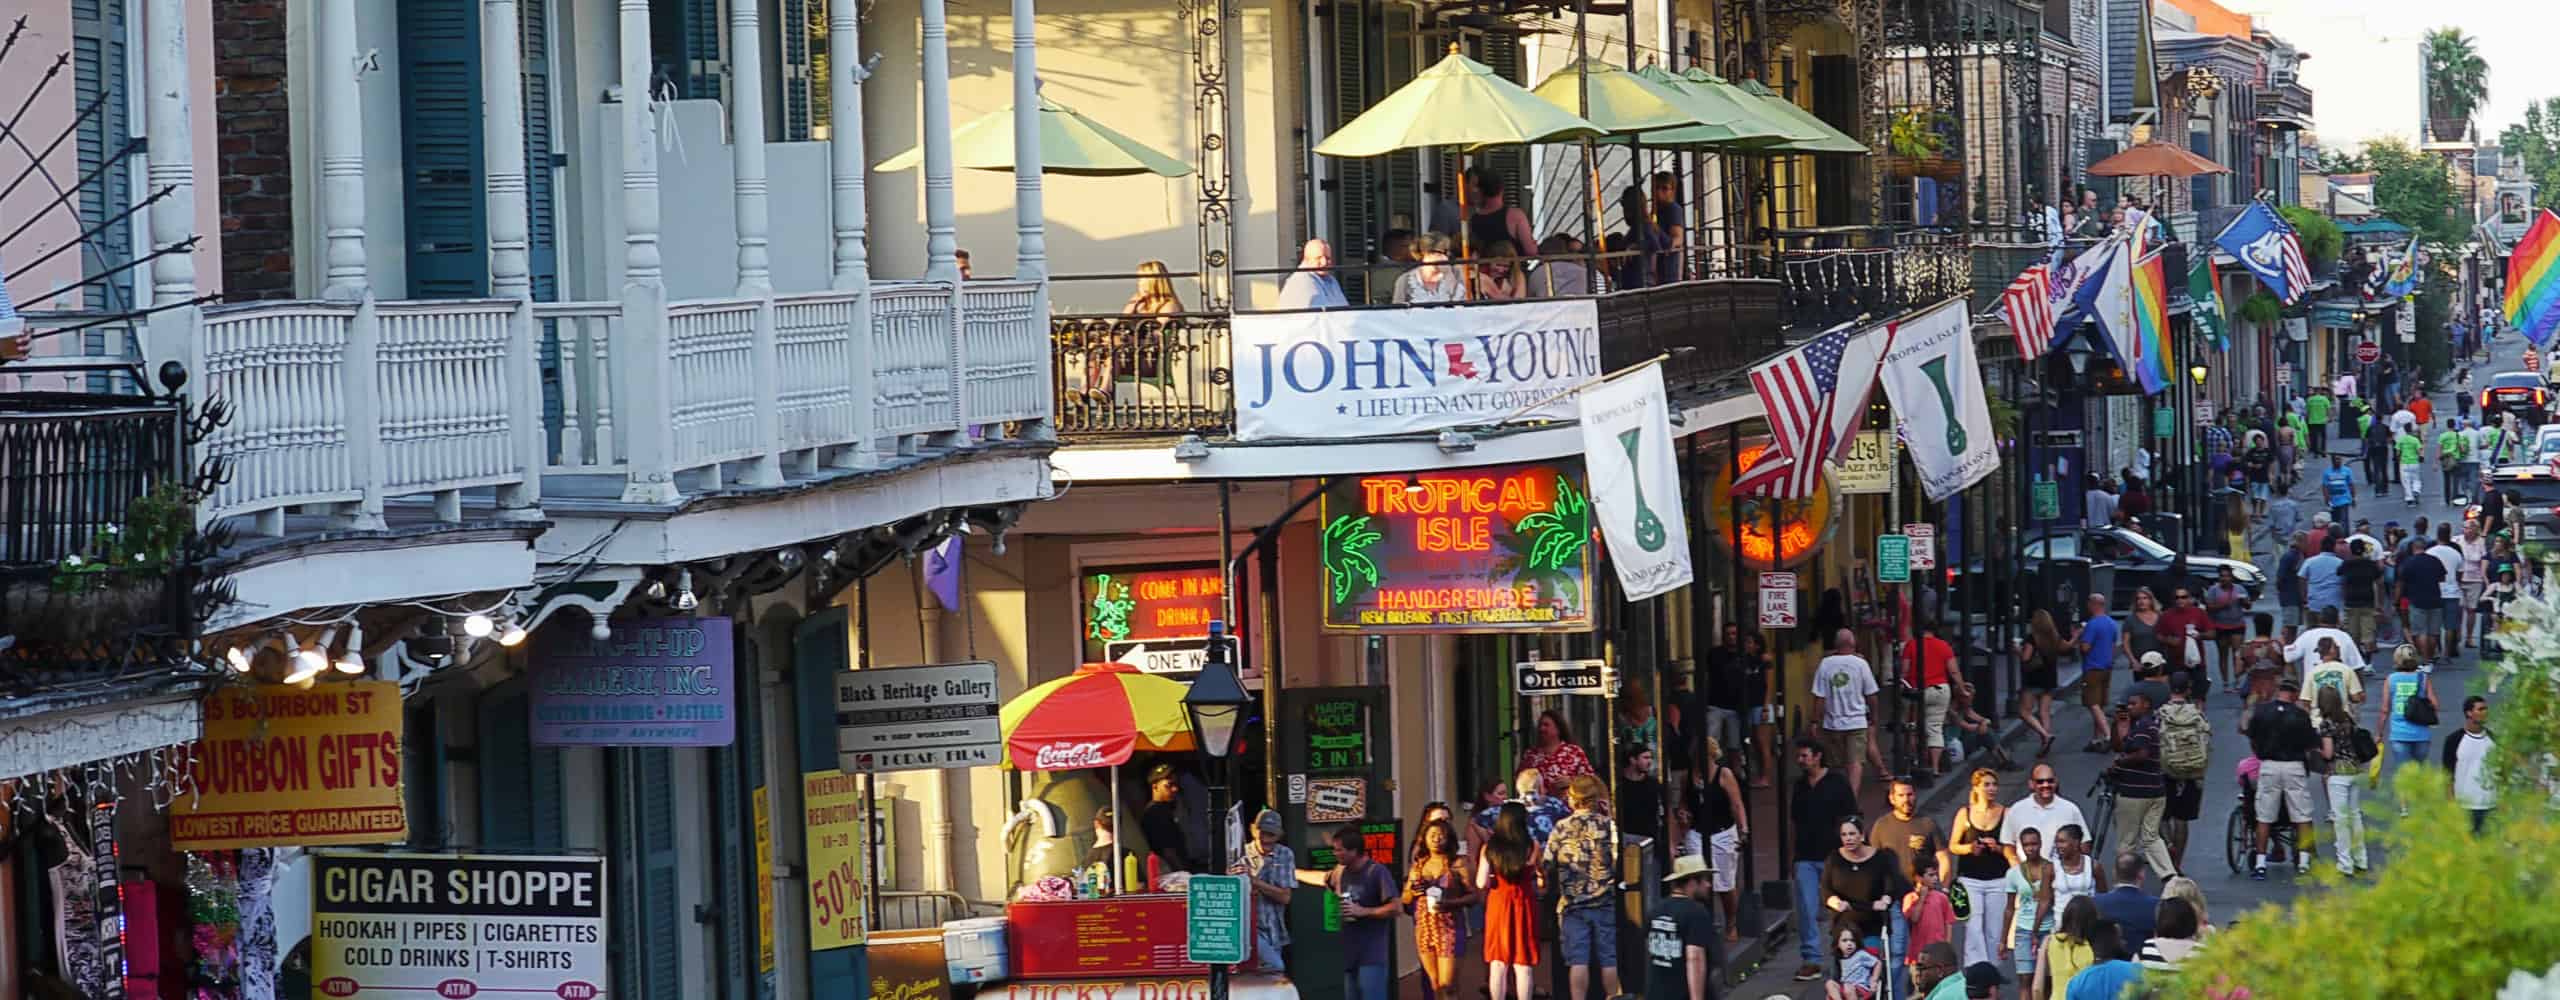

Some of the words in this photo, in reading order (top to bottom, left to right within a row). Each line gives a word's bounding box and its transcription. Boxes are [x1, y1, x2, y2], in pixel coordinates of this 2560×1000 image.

[1887, 335, 1936, 363] TROPICAL
[1251, 338, 1439, 409] JOHN
[1476, 327, 1597, 384] YOUNG
[1357, 392, 1489, 418] LIEUTENANT
[1361, 477, 1546, 514] TROPICAL
[1416, 517, 1491, 551] ISLE
[1140, 580, 1178, 600] COME
[1182, 578, 1198, 596] IN
[1767, 591, 1786, 600] FIRE
[1157, 608, 1199, 627] DRINK
[1202, 608, 1211, 624] A
[1360, 611, 1385, 623] NEW
[1439, 610, 1470, 623] MOST
[1767, 603, 1787, 611] LANE
[1147, 653, 1180, 671] ONE
[664, 665, 719, 696] INC.
[1524, 671, 1598, 687] Orleans
[840, 685, 877, 702] Black
[882, 681, 938, 703] Heritage
[944, 679, 992, 698] Gallery
[231, 693, 340, 720] BOURBON
[346, 691, 374, 715] ST
[1315, 702, 1357, 714] HAPPY
[916, 729, 972, 739] WORLDWIDE
[177, 736, 309, 795] OURBON
[318, 731, 399, 790] GIFTS
[946, 749, 986, 762] FILM
[1036, 743, 1105, 768] Coca-Cola
[1312, 752, 1323, 768] 3
[1330, 752, 1348, 766] IN
[1356, 752, 1364, 766] 1
[174, 816, 240, 838] LOWEST
[243, 812, 291, 835] PRICE
[297, 810, 401, 831] GUARANTEED
[808, 804, 858, 827] REDUCTION
[324, 866, 435, 904] CIGAR
[447, 869, 593, 907] SHOPPE
[813, 856, 862, 926] 50%
[1206, 884, 1237, 892] BOTTLES
[320, 920, 396, 939] HOOKAH
[414, 922, 467, 941] PIPES
[484, 924, 598, 943] CIGARETTES
[841, 916, 864, 940] OFF
[344, 948, 393, 966] COLD
[400, 949, 470, 967] DRINKS
[488, 951, 572, 969] T-SHIRTS
[327, 981, 352, 993] ATM
[444, 982, 471, 995] ATM
[564, 985, 591, 998] ATM
[1007, 983, 1125, 1000] LUCKY
